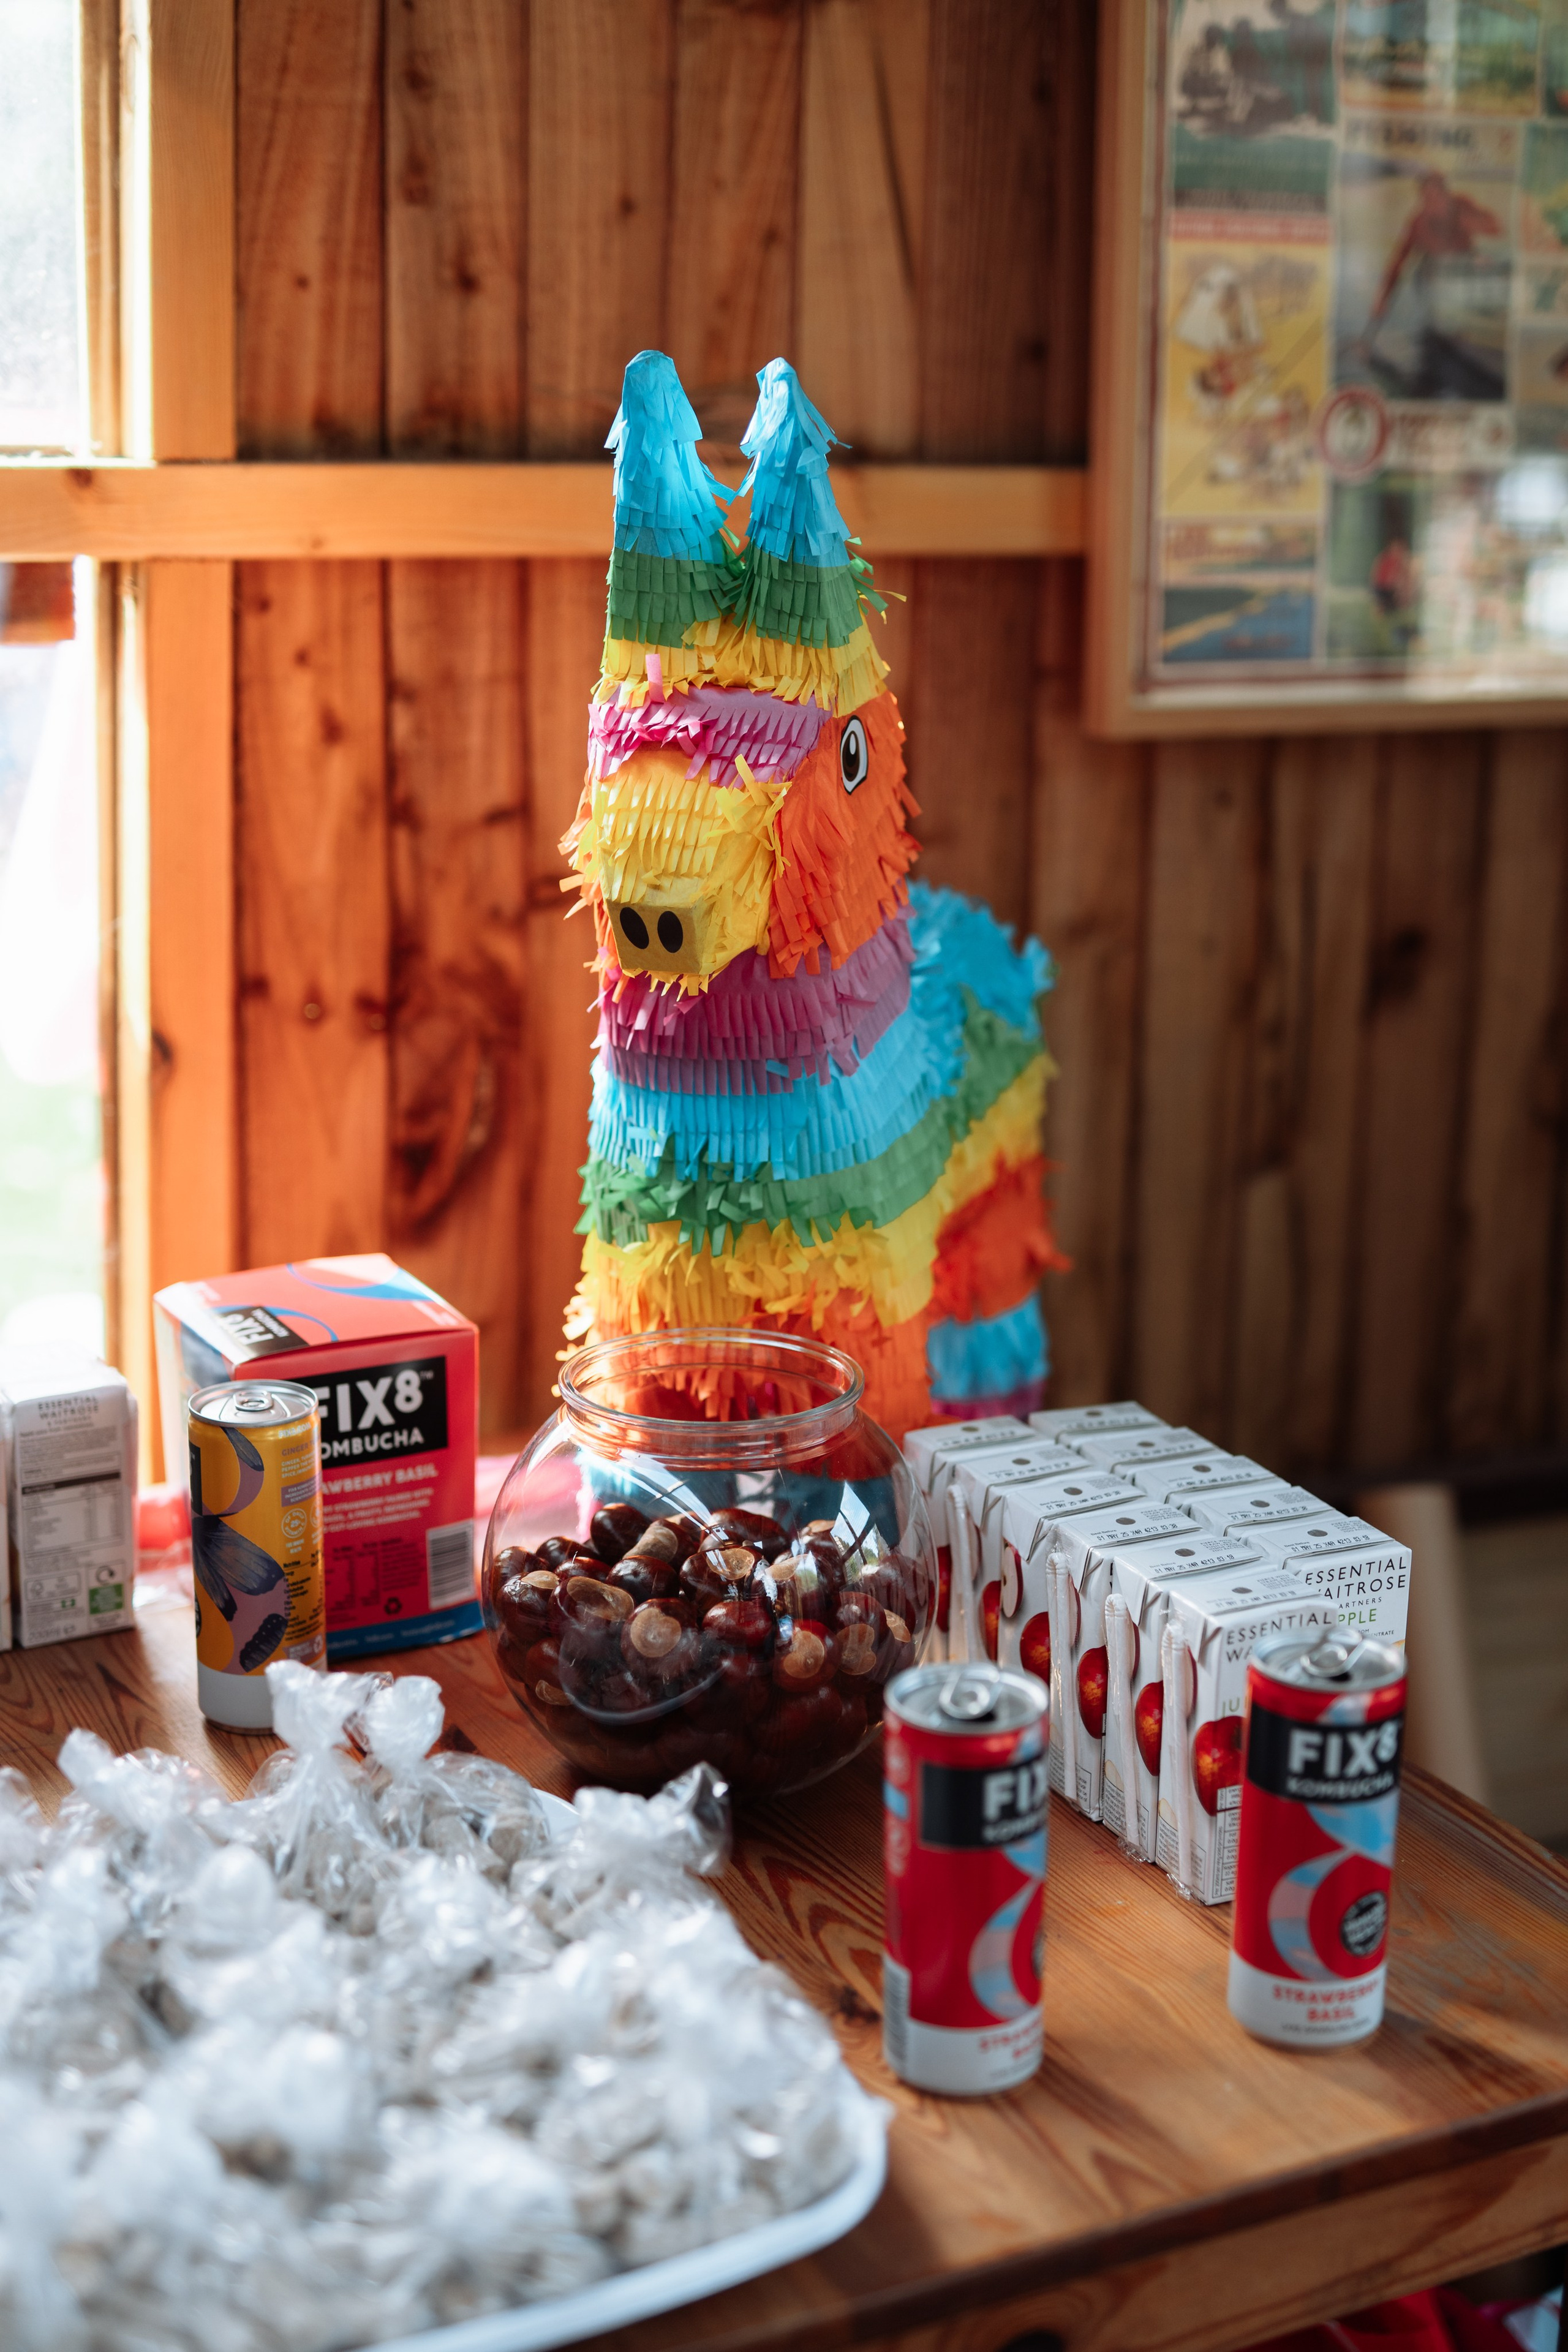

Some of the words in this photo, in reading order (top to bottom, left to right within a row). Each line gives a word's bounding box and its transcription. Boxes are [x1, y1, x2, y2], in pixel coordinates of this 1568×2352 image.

[281, 1442, 309, 1457] GINGER
[321, 1427, 424, 1460] OMBUCHA
[322, 1471, 393, 1495] AWBERRY
[395, 1463, 438, 1483] BASIL
[1305, 1556, 1406, 1585] ESSENTIAL
[1319, 1574, 1406, 1599] AITROSE
[1339, 1597, 1382, 1608] ARTNERS
[1226, 1612, 1332, 1645] ESSENTIAL
[1338, 1608, 1377, 1626] PPLE
[1289, 1722, 1398, 1777] FIX8
[1307, 2006, 1355, 2022] BASIL
